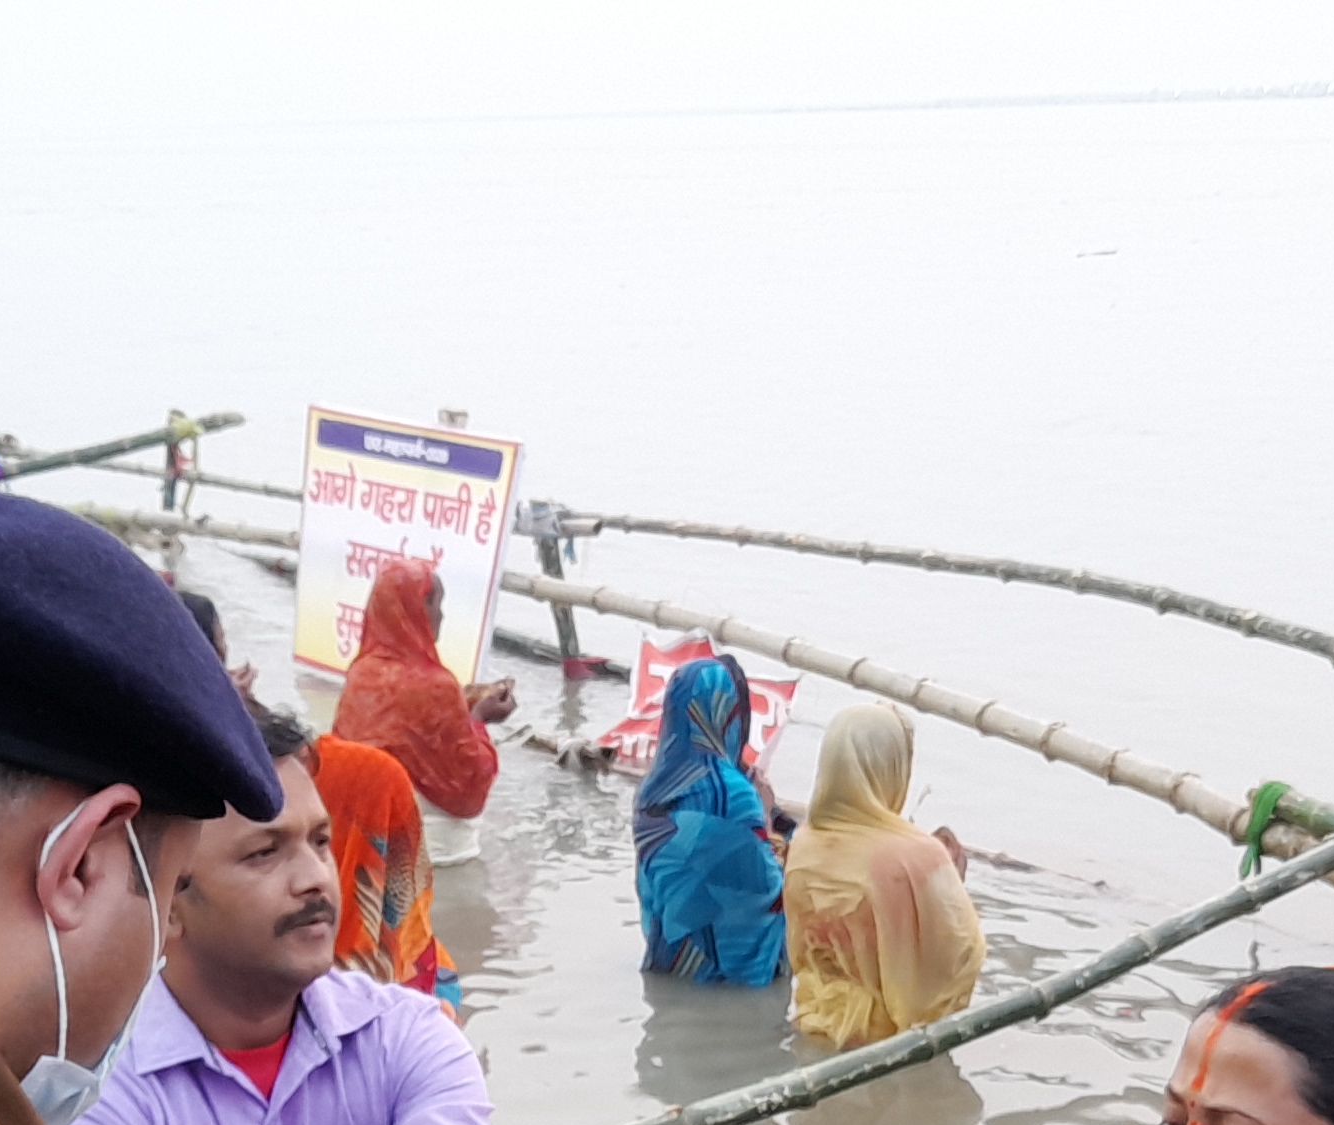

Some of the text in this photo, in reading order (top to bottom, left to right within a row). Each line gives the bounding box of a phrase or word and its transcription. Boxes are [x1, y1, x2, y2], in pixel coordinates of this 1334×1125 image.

[308, 462, 497, 546] आगे गहरा पानी है
